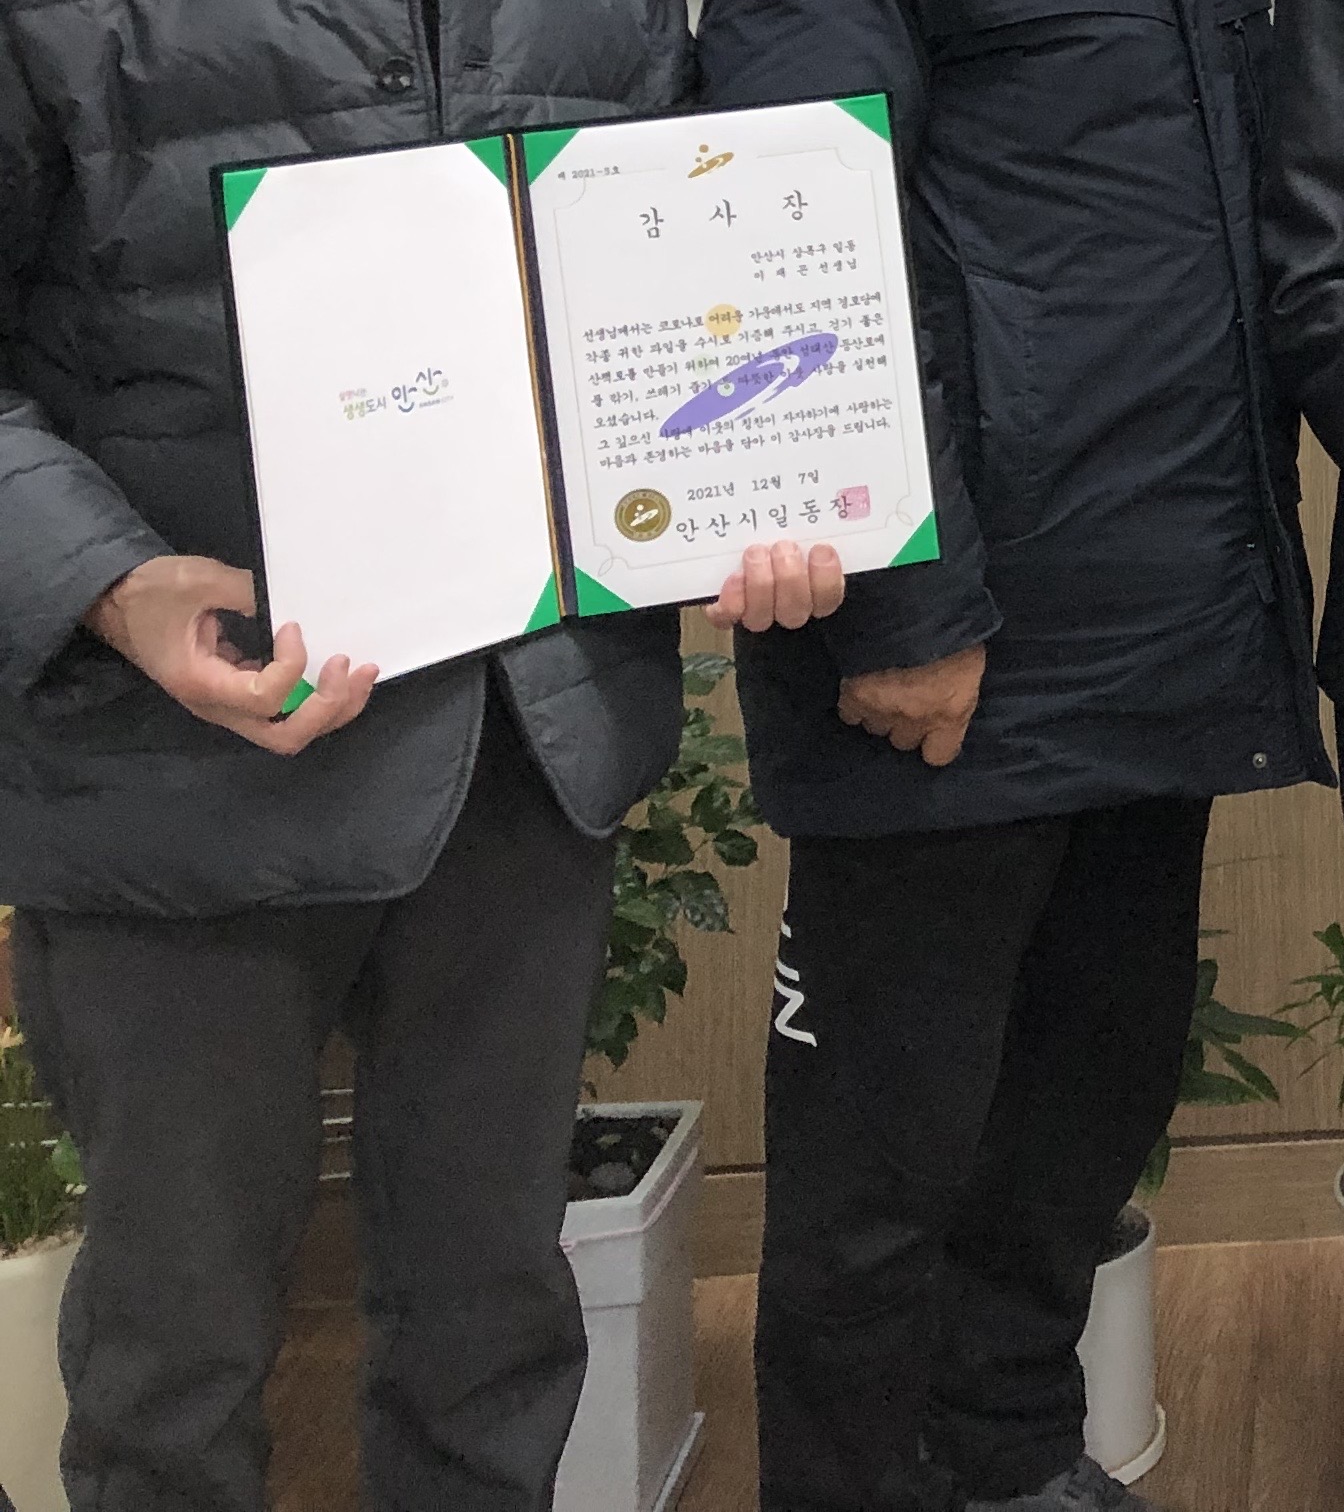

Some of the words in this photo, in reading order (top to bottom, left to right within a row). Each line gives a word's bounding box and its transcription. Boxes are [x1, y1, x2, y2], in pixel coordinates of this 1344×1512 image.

[658, 316, 704, 331] 코로나로
[811, 298, 831, 310] 지역
[687, 482, 735, 501] 2021년
[752, 475, 782, 492] 12월
[798, 470, 819, 485] 7일
